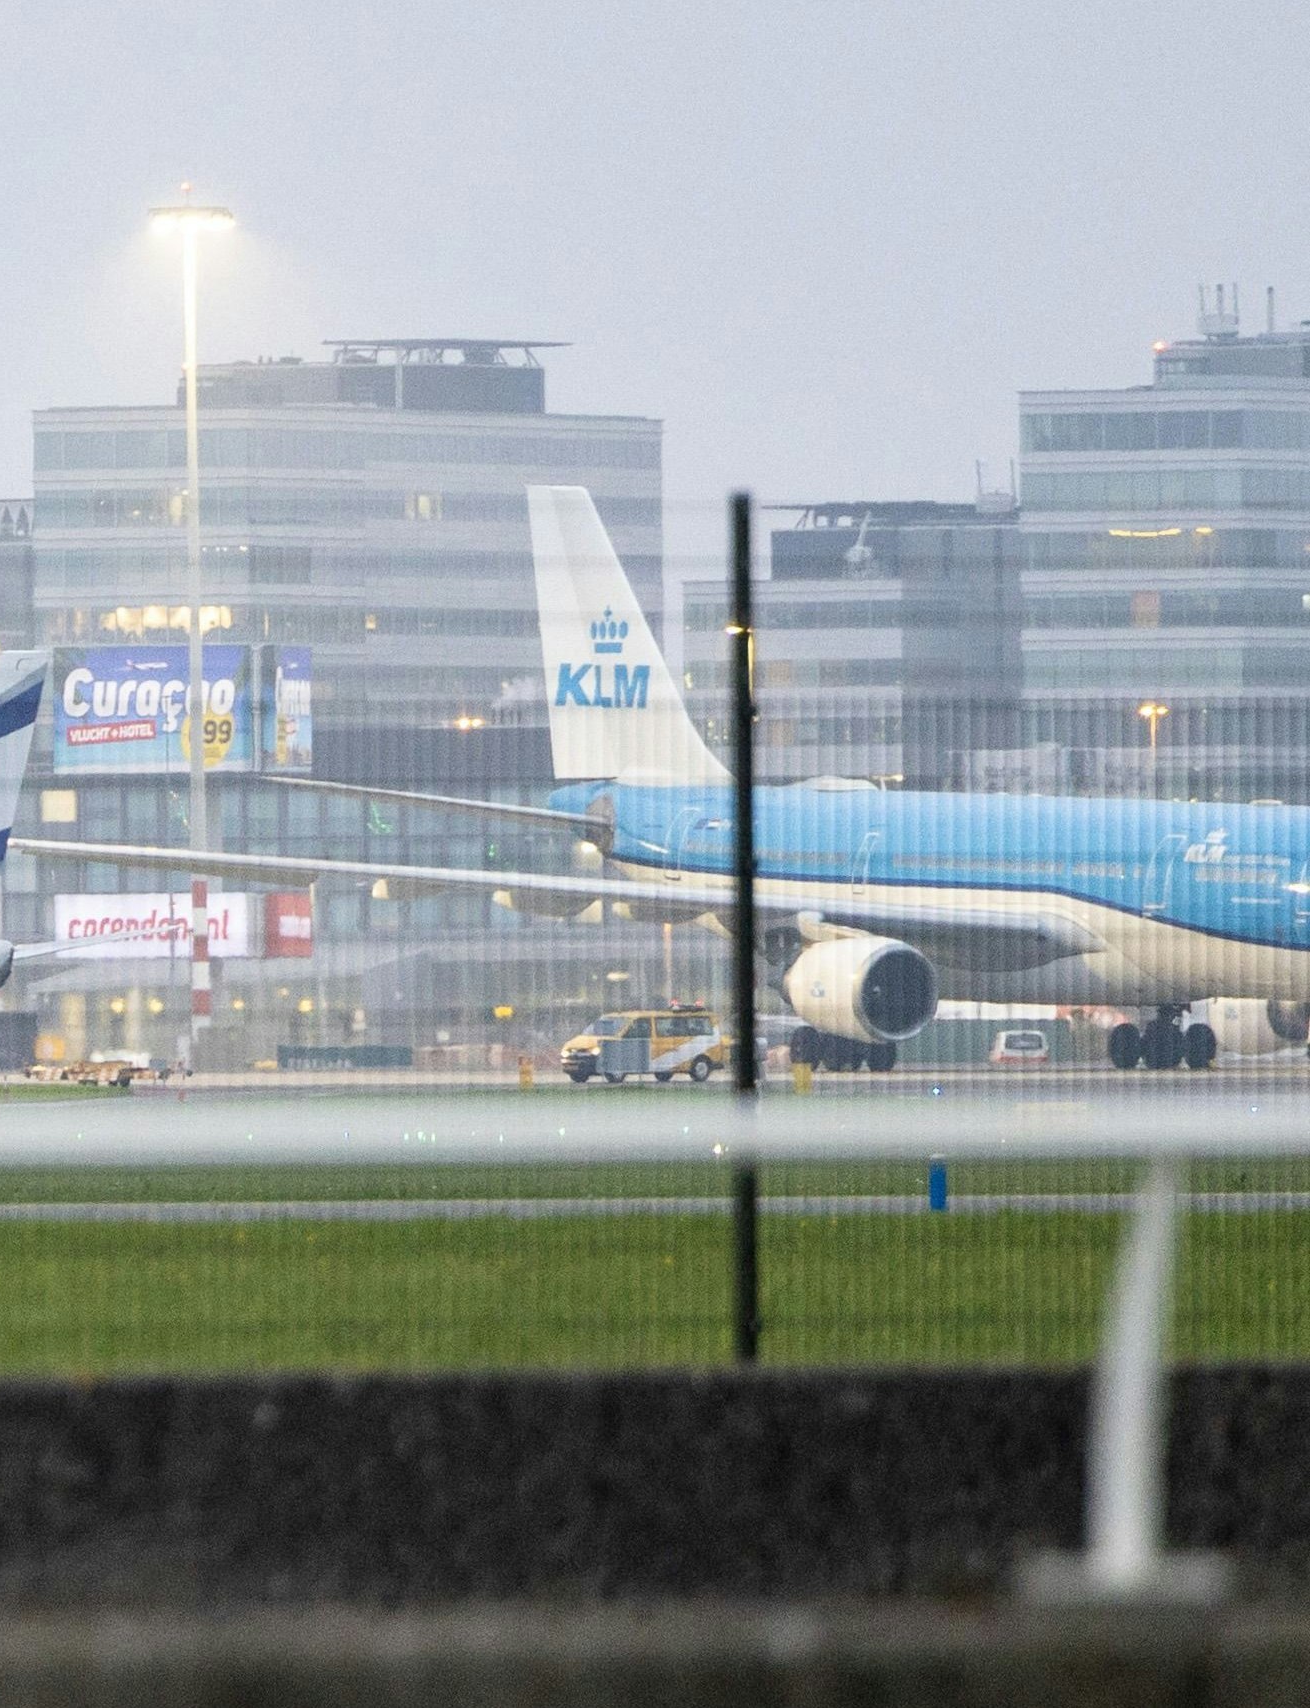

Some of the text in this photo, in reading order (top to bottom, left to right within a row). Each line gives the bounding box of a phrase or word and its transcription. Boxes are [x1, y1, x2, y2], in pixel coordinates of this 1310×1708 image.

[555, 663, 650, 708] KLM
[119, 722, 155, 739] HOTEL
[68, 909, 229, 940] corendonnl
